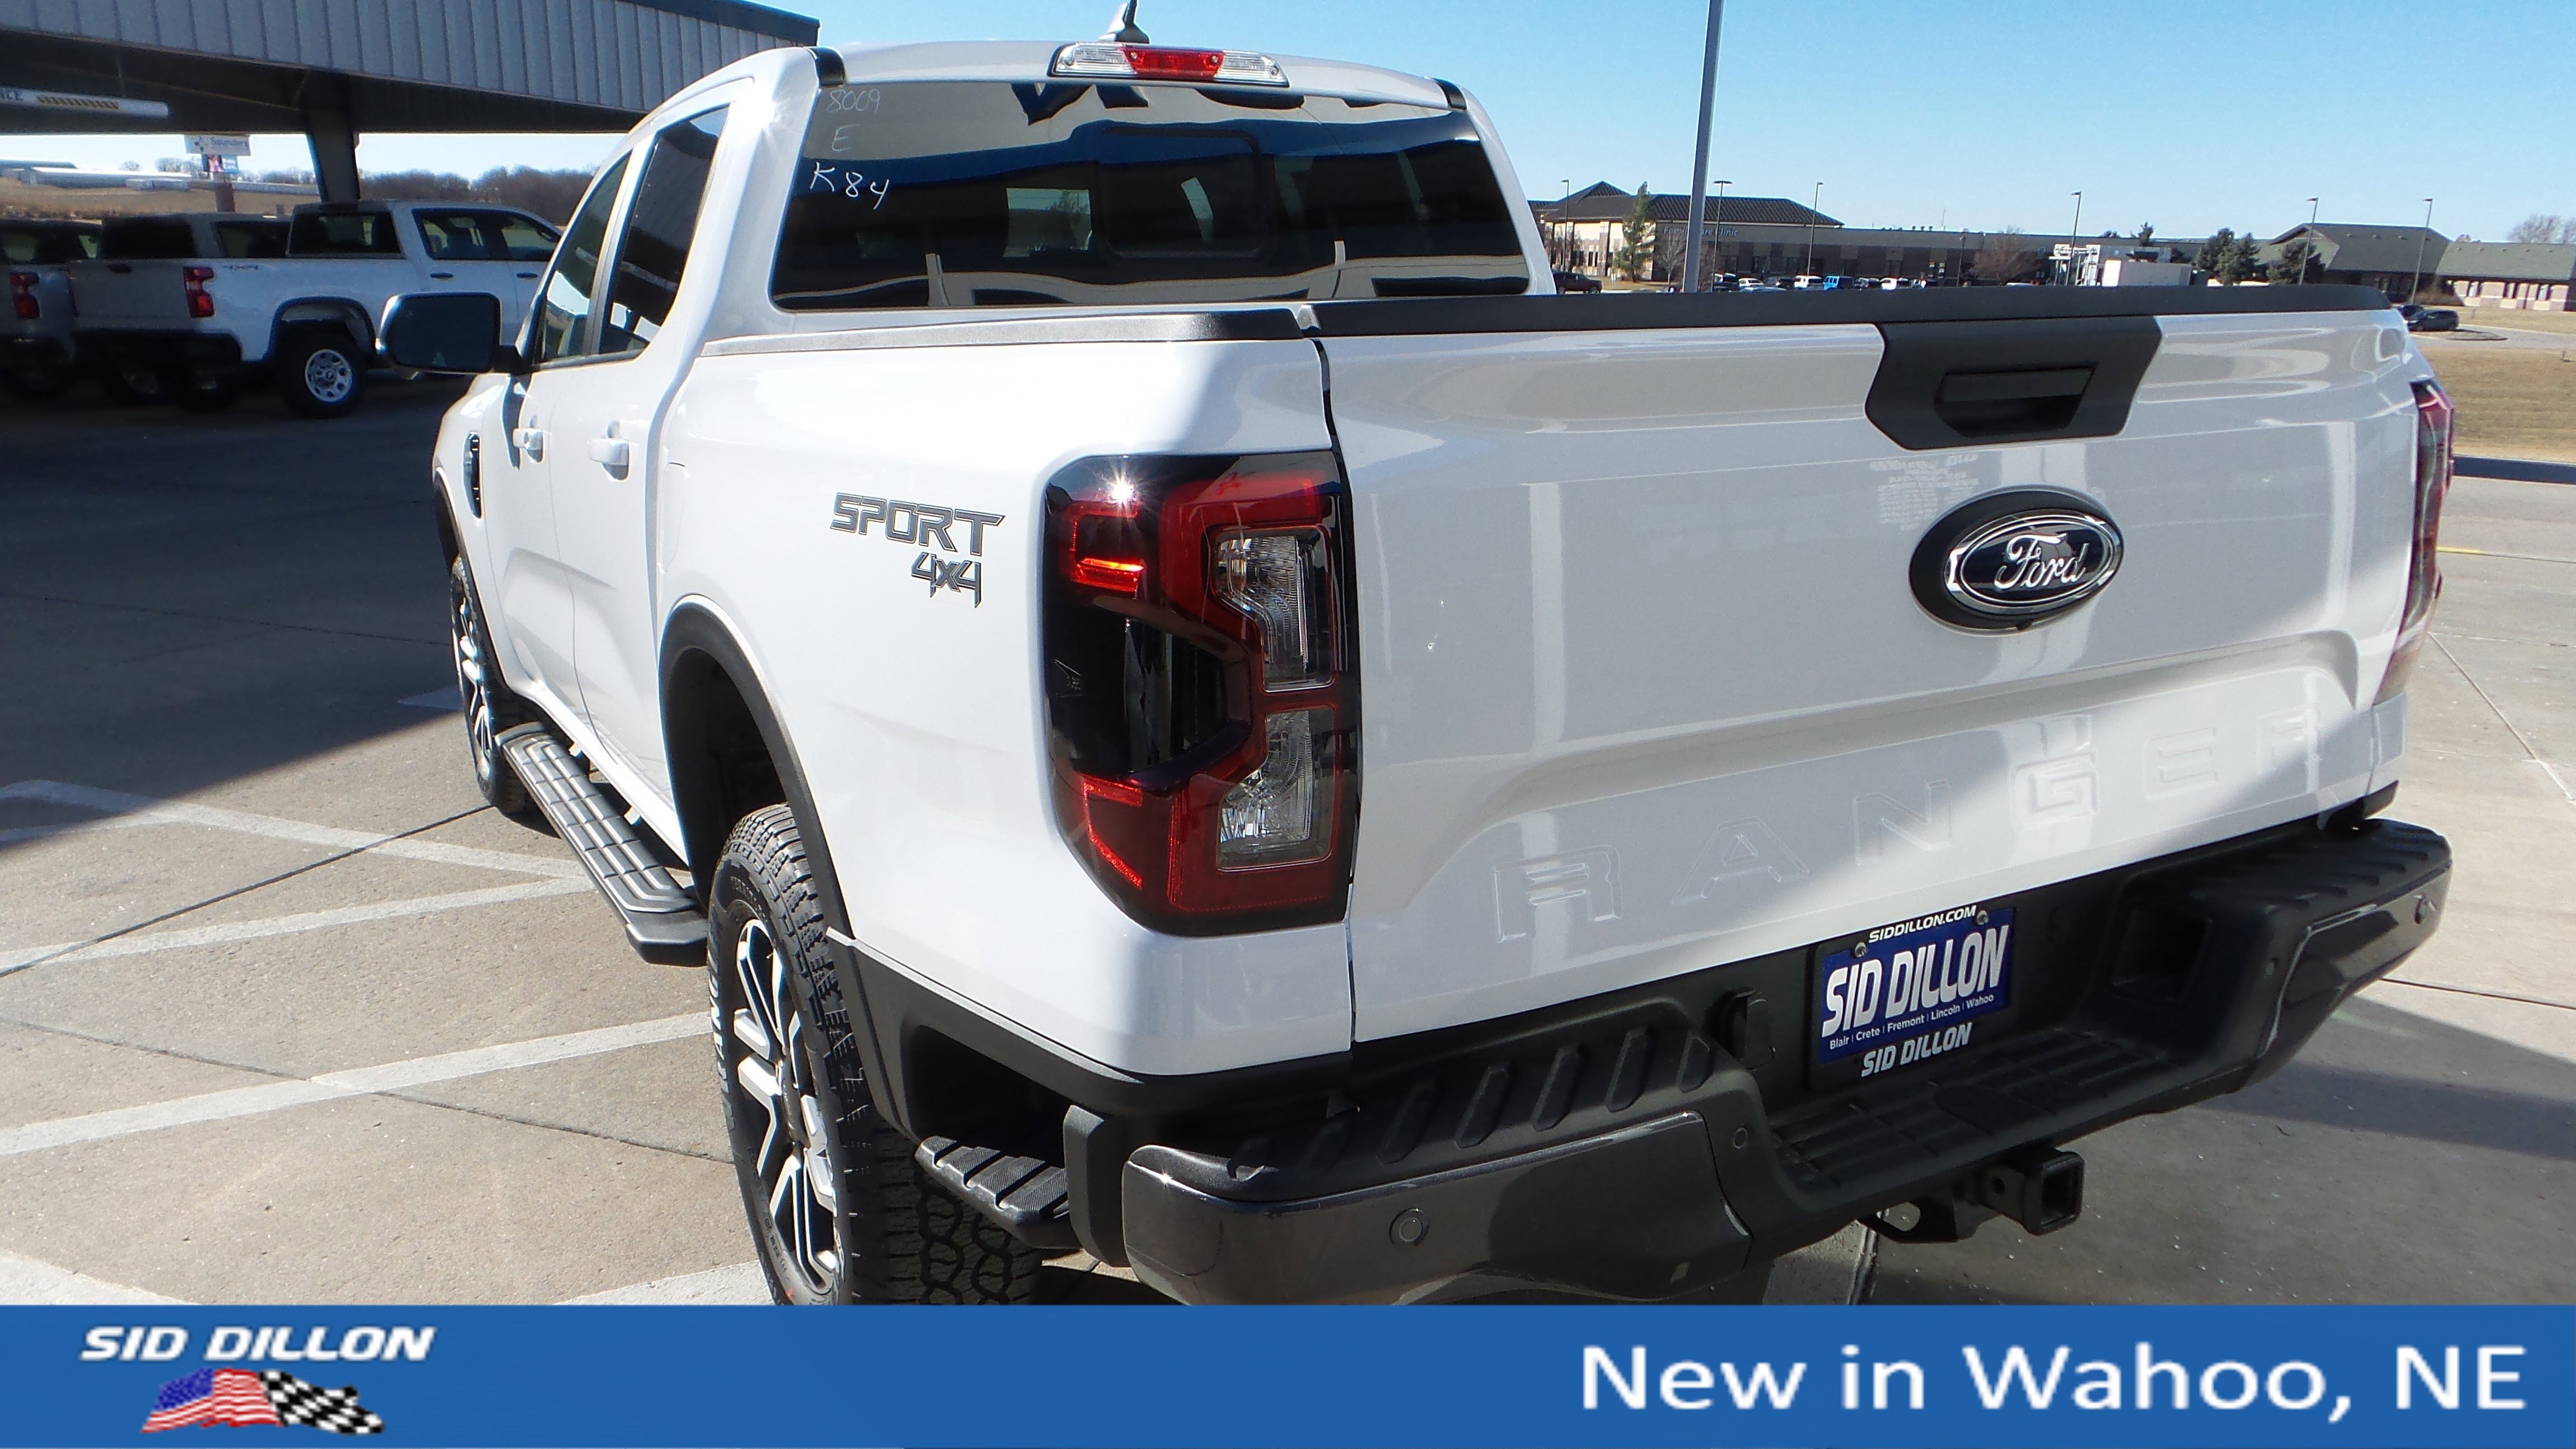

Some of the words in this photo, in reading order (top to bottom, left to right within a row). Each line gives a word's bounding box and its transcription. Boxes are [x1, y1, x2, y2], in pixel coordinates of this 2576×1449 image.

[832, 124, 860, 151] E
[1664, 225, 1688, 235] Famil
[830, 492, 1006, 557] SPORT
[1993, 532, 2089, 592] Ford
[1493, 704, 2320, 945] RANGER
[1868, 905, 1977, 944] SIDDILLON.COM
[1821, 959, 1883, 1038] SID
[1885, 924, 2009, 1019] DILLON
[1830, 1035, 1849, 1050] Blair
[1855, 1027, 1881, 1041] Crete
[1887, 1015, 1925, 1033] Fremont
[1931, 1004, 1961, 1021] Lincoln
[1966, 993, 1995, 1010] Wahoo
[1860, 1045, 1897, 1078] SID
[1900, 1021, 1973, 1066] DILLON
